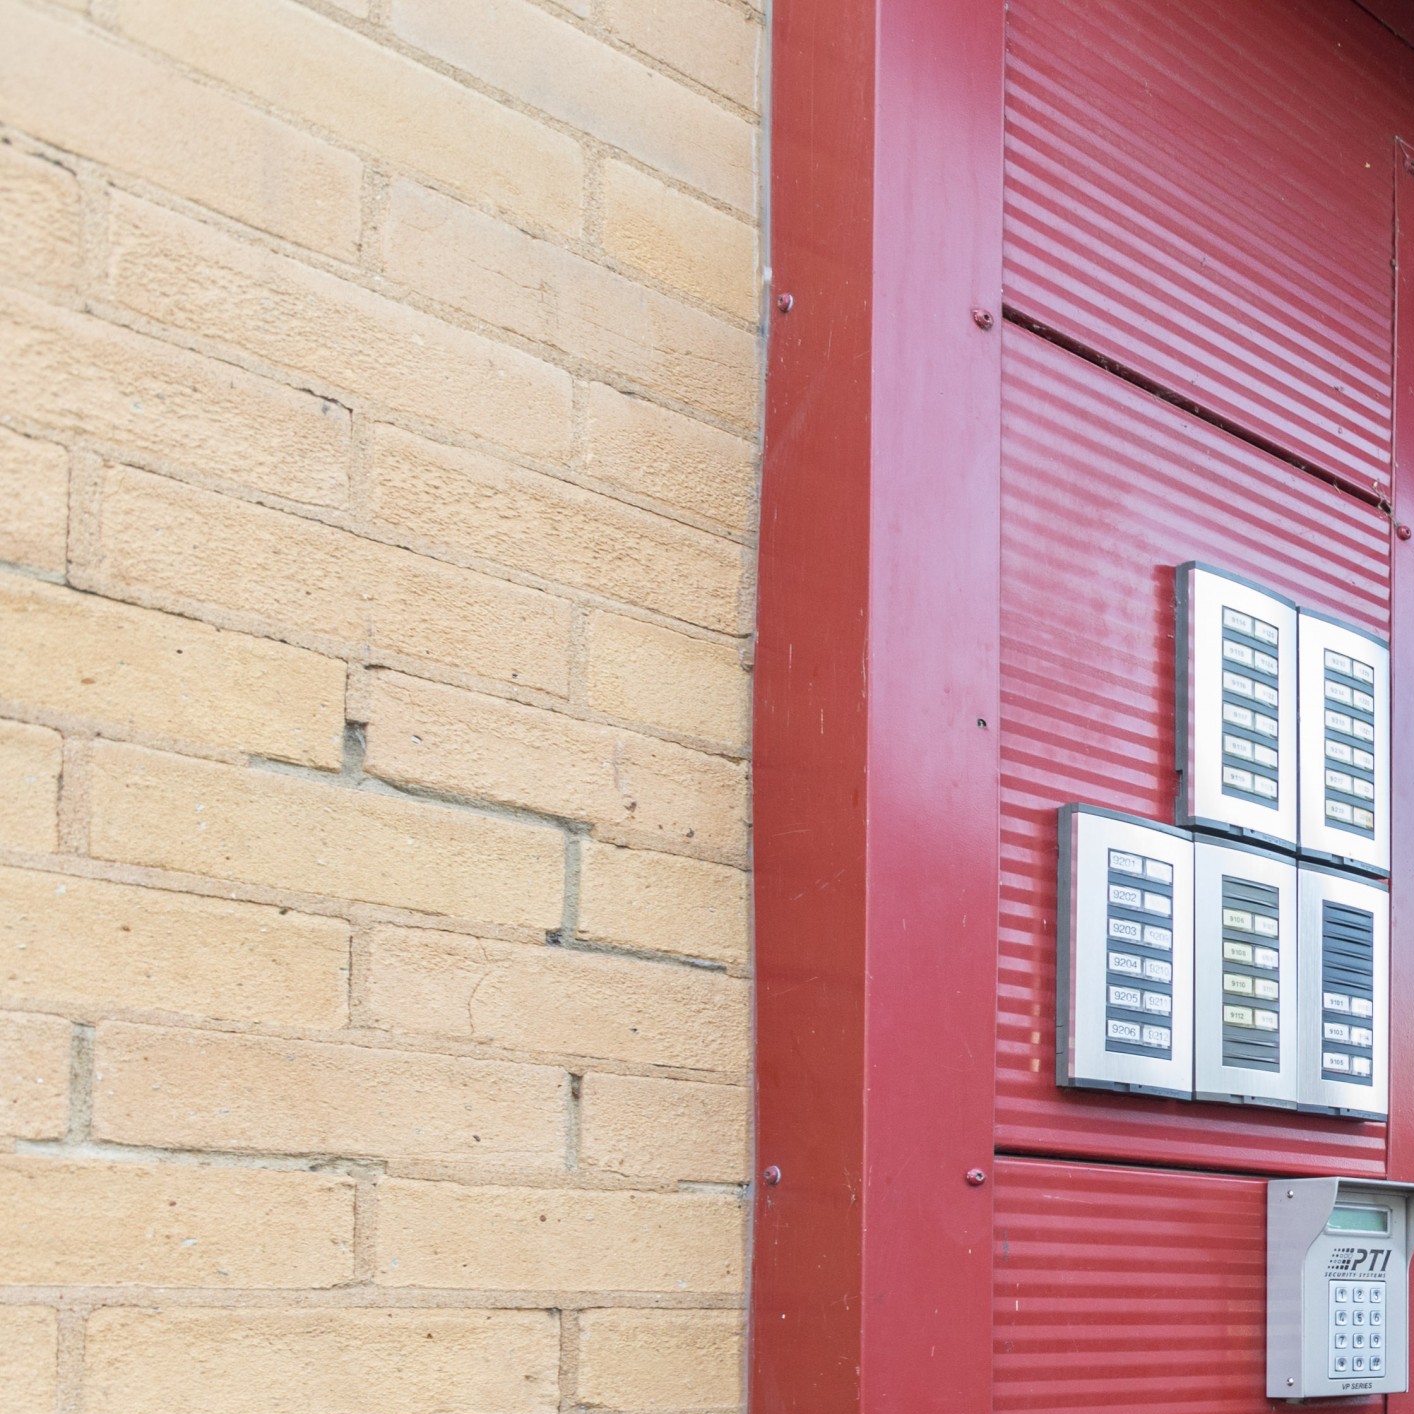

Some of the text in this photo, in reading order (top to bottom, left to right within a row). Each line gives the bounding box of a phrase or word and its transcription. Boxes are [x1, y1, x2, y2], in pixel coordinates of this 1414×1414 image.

[1112, 855, 1135, 871] 9201
[1113, 889, 1137, 903] 9202
[1229, 915, 1245, 924] 9106
[1113, 924, 1137, 937] 9203
[1114, 957, 1137, 971] 9204
[1231, 980, 1246, 989] 9110
[1114, 991, 1137, 1004] 9205
[1330, 999, 1344, 1007] 9101
[1230, 1011, 1245, 1021] 9112
[1112, 1024, 1136, 1038] 9206
[1329, 1028, 1343, 1037] 9103
[1330, 1058, 1344, 1066] 9105
[1351, 1248, 1392, 1272] PTI
[1350, 1382, 1372, 1390] SERIES
